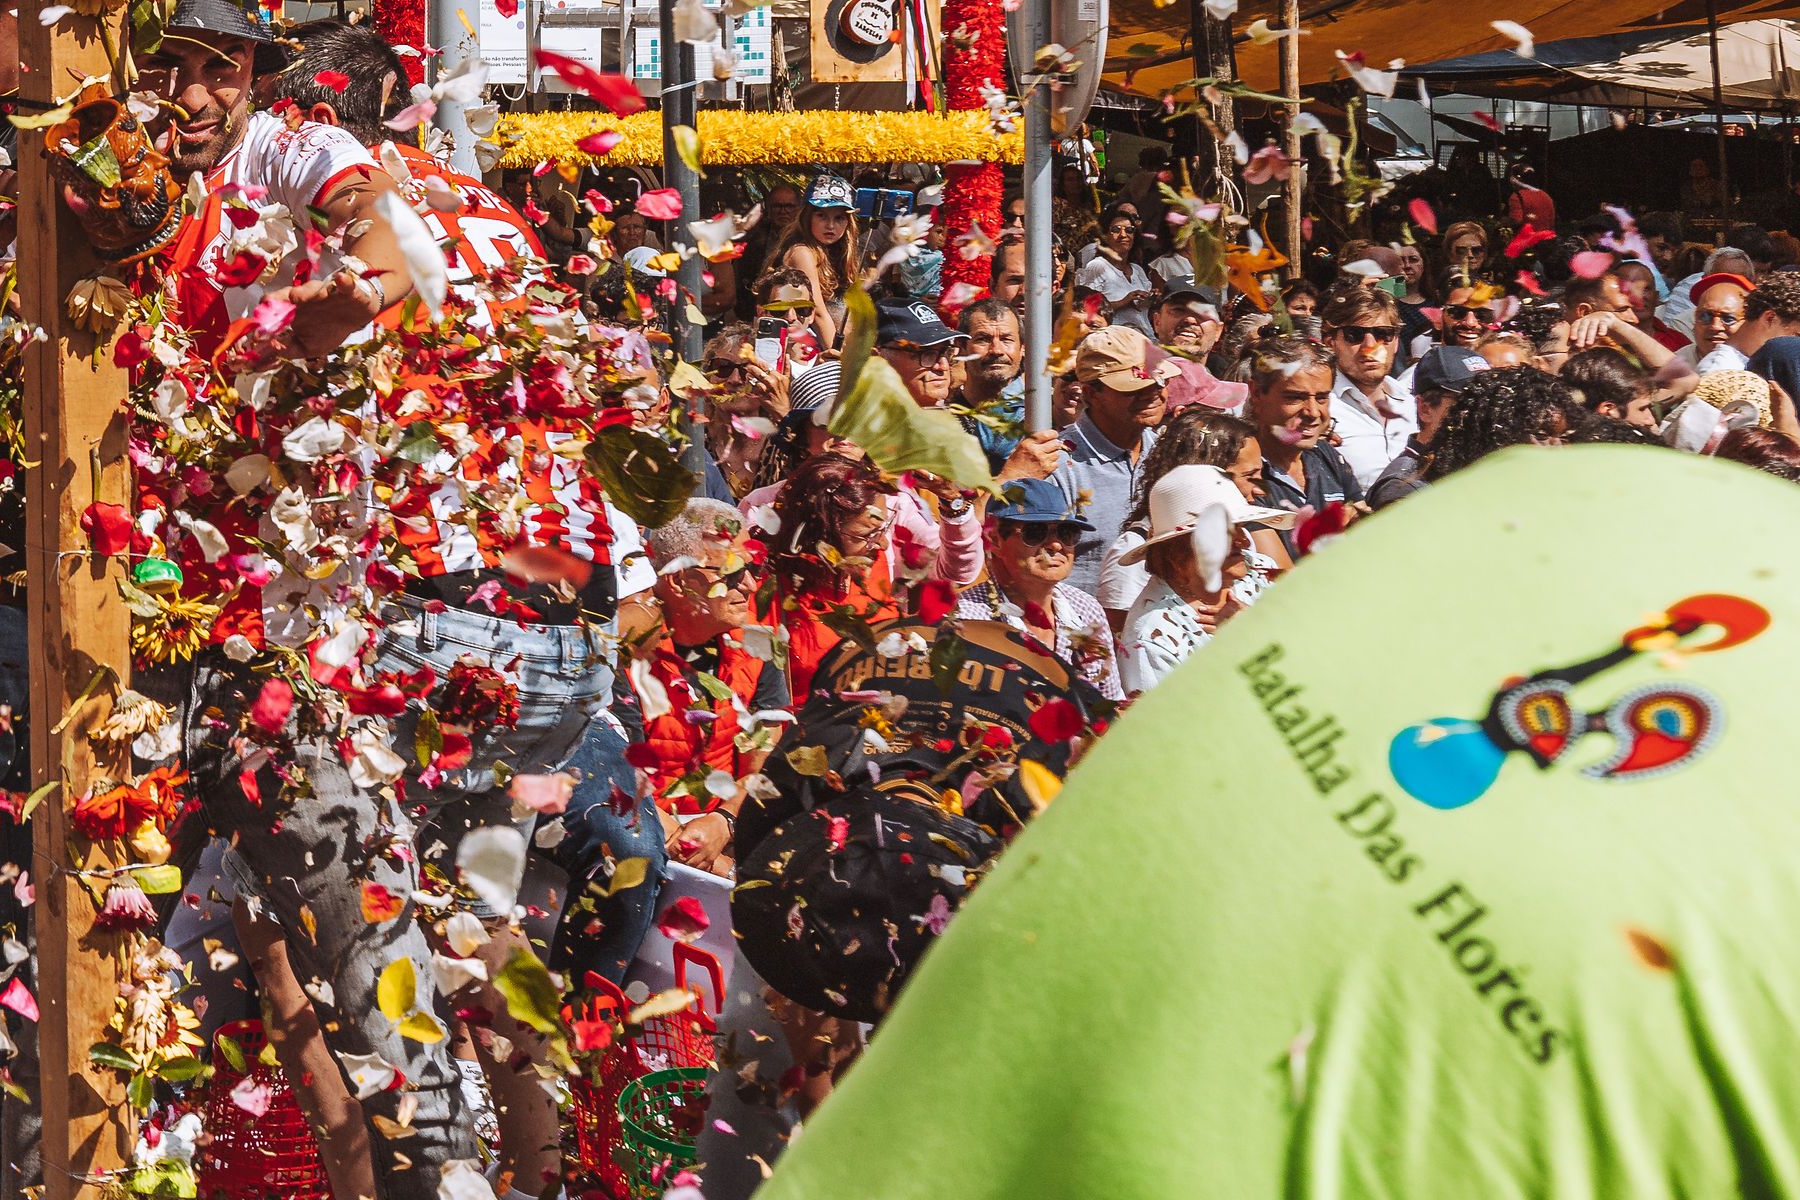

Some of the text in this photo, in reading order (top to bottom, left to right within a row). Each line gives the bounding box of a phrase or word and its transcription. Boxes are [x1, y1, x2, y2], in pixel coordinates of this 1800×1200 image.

[1236, 641, 1561, 1067] Batalha Das Flores
